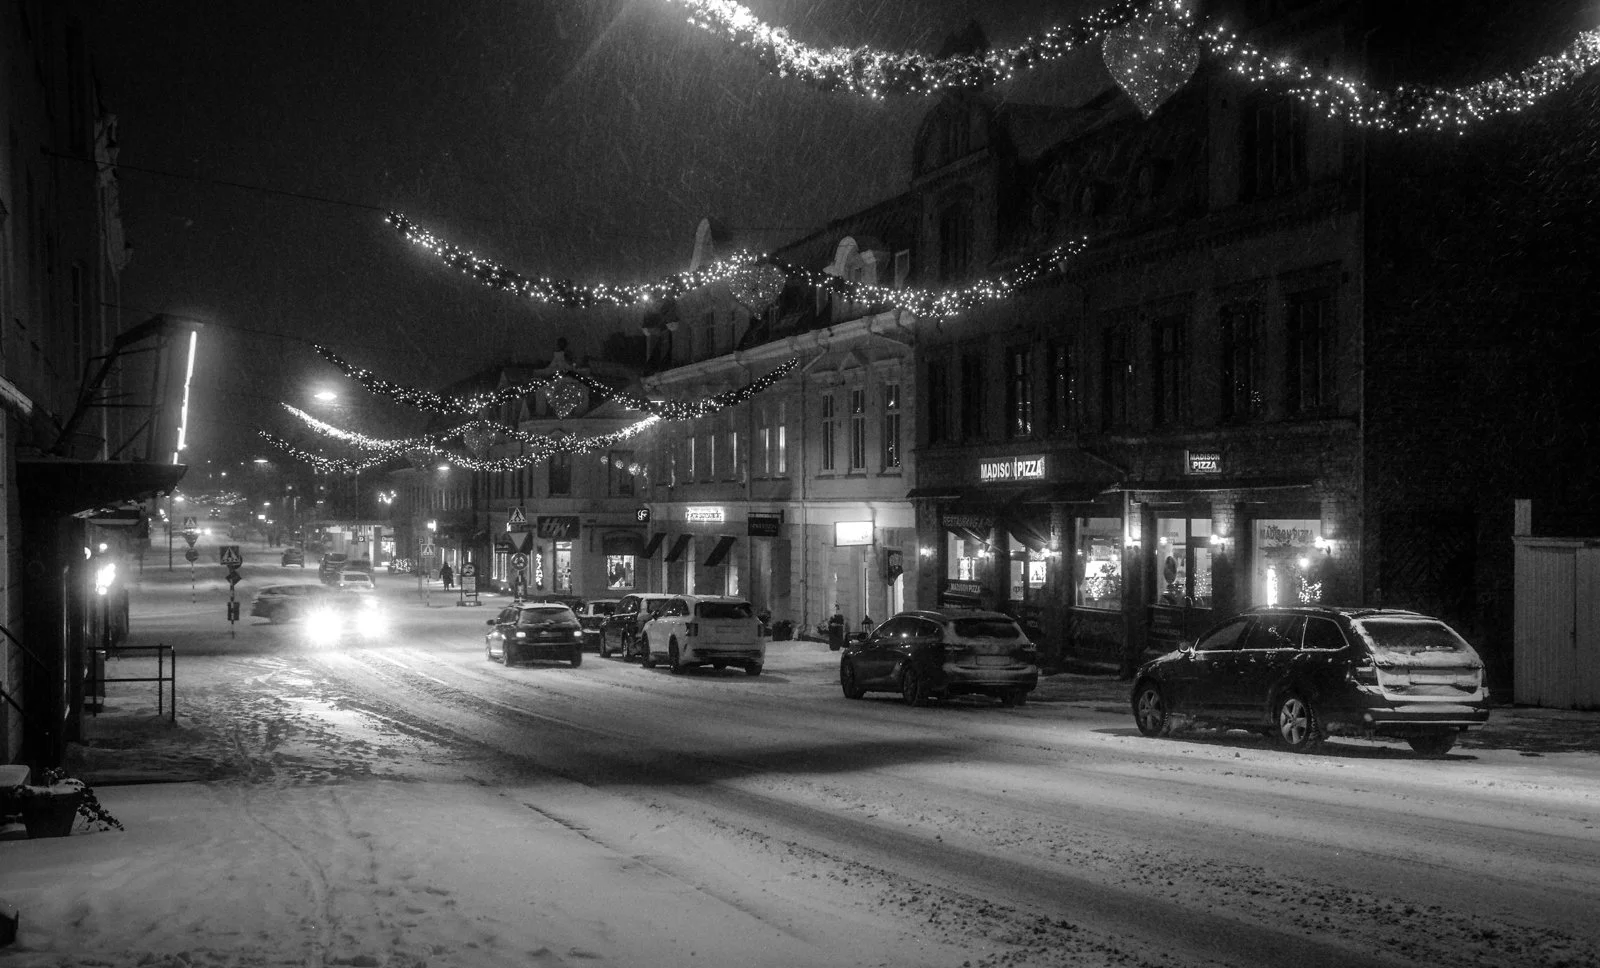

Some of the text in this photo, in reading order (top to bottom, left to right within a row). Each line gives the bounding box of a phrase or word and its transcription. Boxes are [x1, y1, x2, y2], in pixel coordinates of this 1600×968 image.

[1190, 453, 1220, 461] MADISON
[981, 460, 1042, 478] MADISON PIZZA
[1193, 461, 1217, 469] PIZZA
